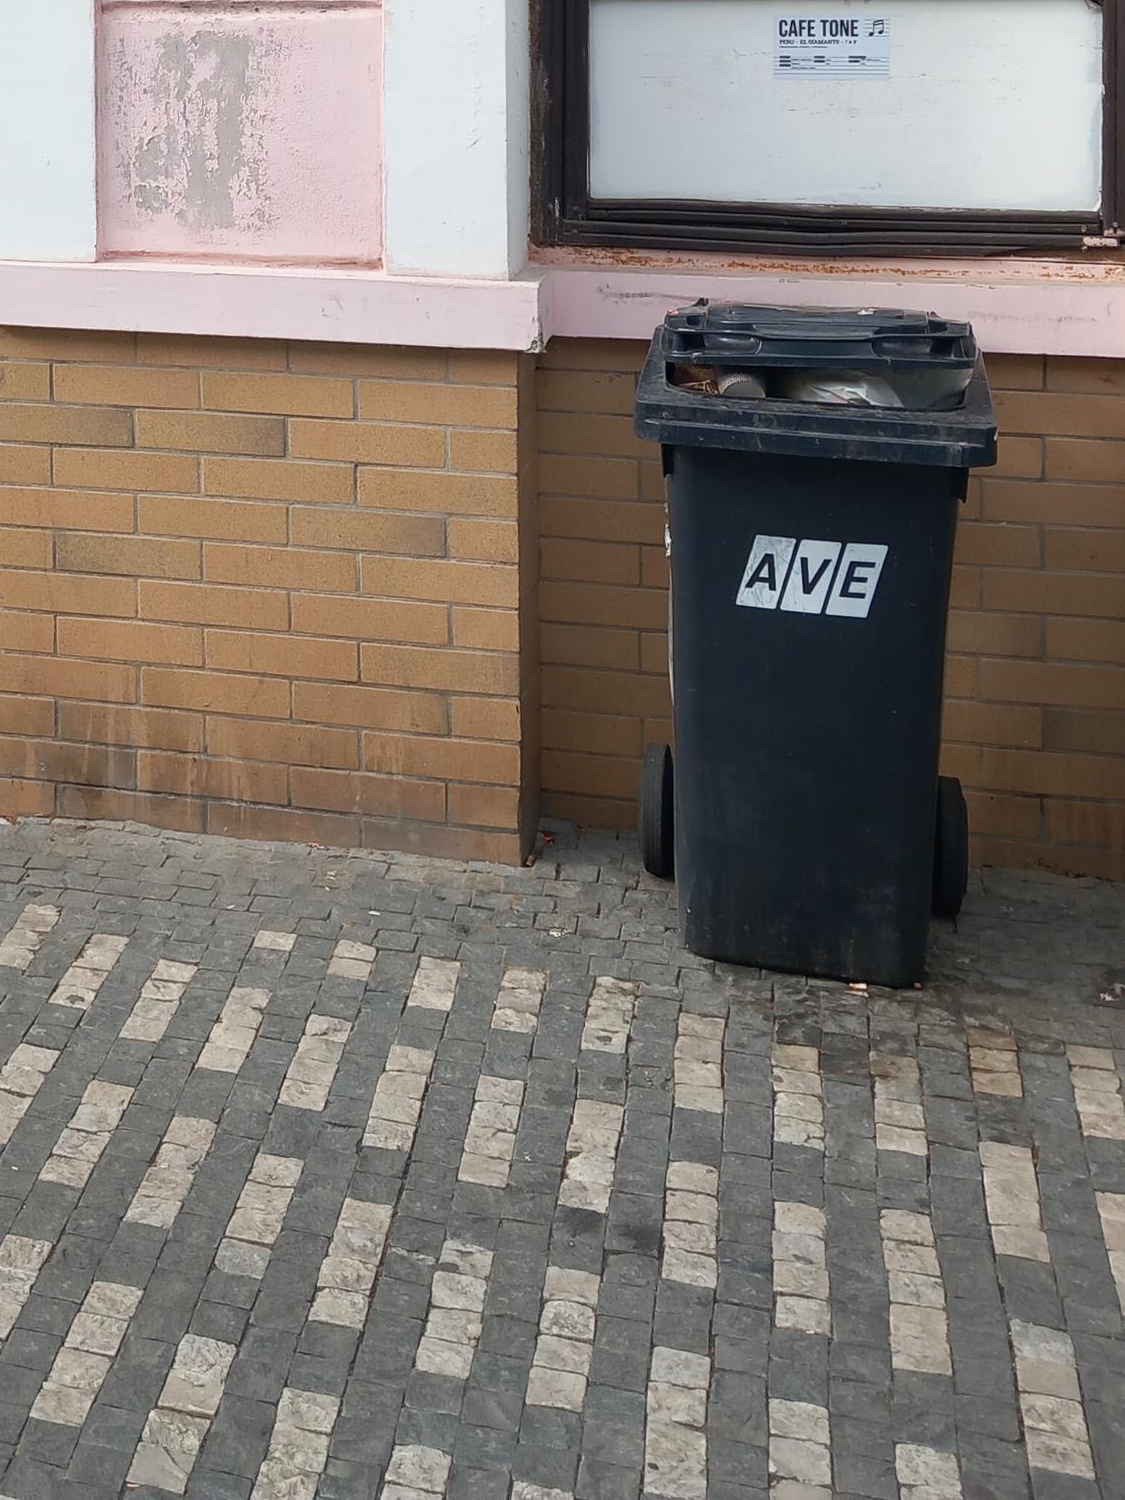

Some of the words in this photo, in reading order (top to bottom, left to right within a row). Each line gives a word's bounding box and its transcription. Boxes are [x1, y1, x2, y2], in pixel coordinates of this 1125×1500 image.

[779, 19, 816, 38] CAFE
[820, 19, 859, 38] TONE
[742, 550, 879, 602] AVE
